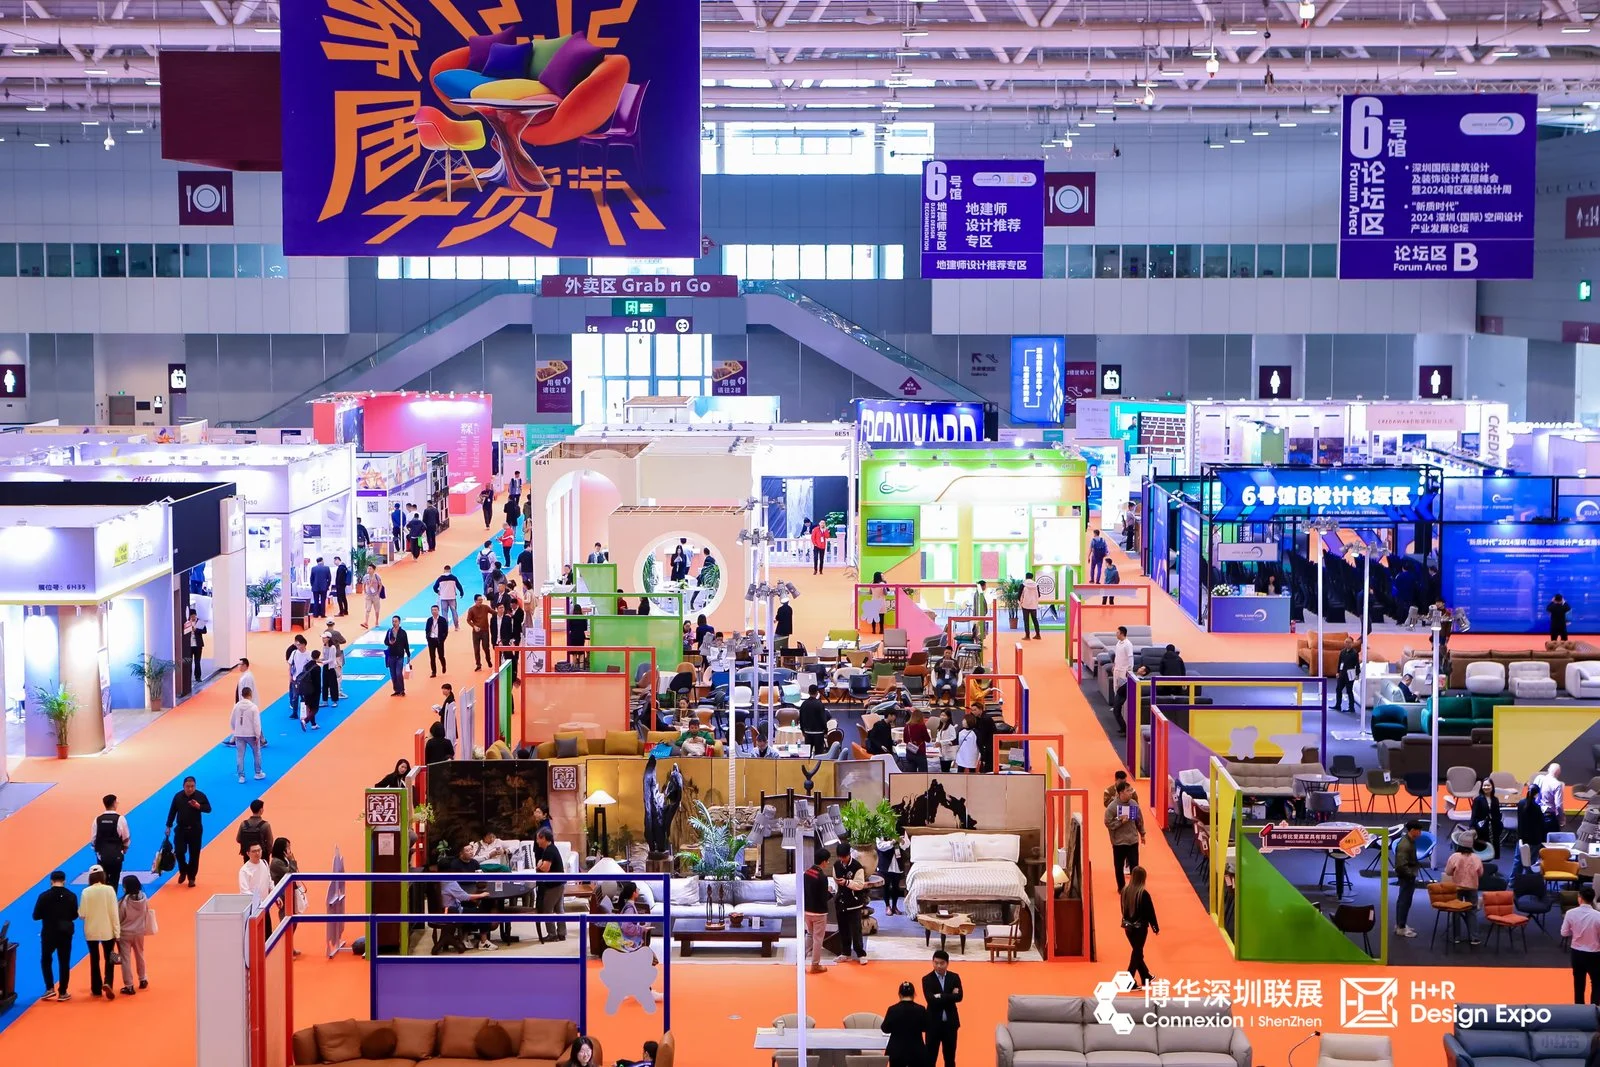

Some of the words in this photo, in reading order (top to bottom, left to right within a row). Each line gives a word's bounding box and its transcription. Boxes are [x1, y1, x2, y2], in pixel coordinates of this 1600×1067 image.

[1350, 97, 1383, 158] 6
[1388, 119, 1406, 158] 号馆
[1411, 163, 1490, 173] 深圳国际建筑设计
[926, 161, 947, 201] 6
[949, 175, 962, 200] 号馆
[1350, 163, 1360, 202] Forum
[1411, 174, 1499, 184] 及装饰设计高层峰会
[1411, 185, 1512, 195] 暨2024湾区硬装设计周
[1361, 161, 1385, 236] 论坛区
[965, 202, 1007, 216] 地建师
[1348, 206, 1359, 235] Area
[1411, 212, 1434, 222] 2024
[936, 202, 947, 251] 地建师专区
[965, 218, 1021, 232] 设计推荐
[1411, 223, 1469, 234] 产业发展论坛
[965, 235, 993, 248] 专区
[1394, 245, 1447, 261] 论坛区
[1453, 242, 1478, 272] B
[936, 260, 1027, 271] 地建师设计推荐专区
[1393, 263, 1423, 271] Forum
[1425, 263, 1447, 271] Area
[565, 277, 617, 295] 外卖区
[622, 278, 666, 293] Grab
[671, 281, 681, 292] n
[686, 279, 711, 293] Go
[640, 319, 655, 333] 10
[546, 379, 562, 387] 用餐
[721, 379, 736, 387] 用餐
[1241, 485, 1411, 506] 6号馆B设计论坛区
